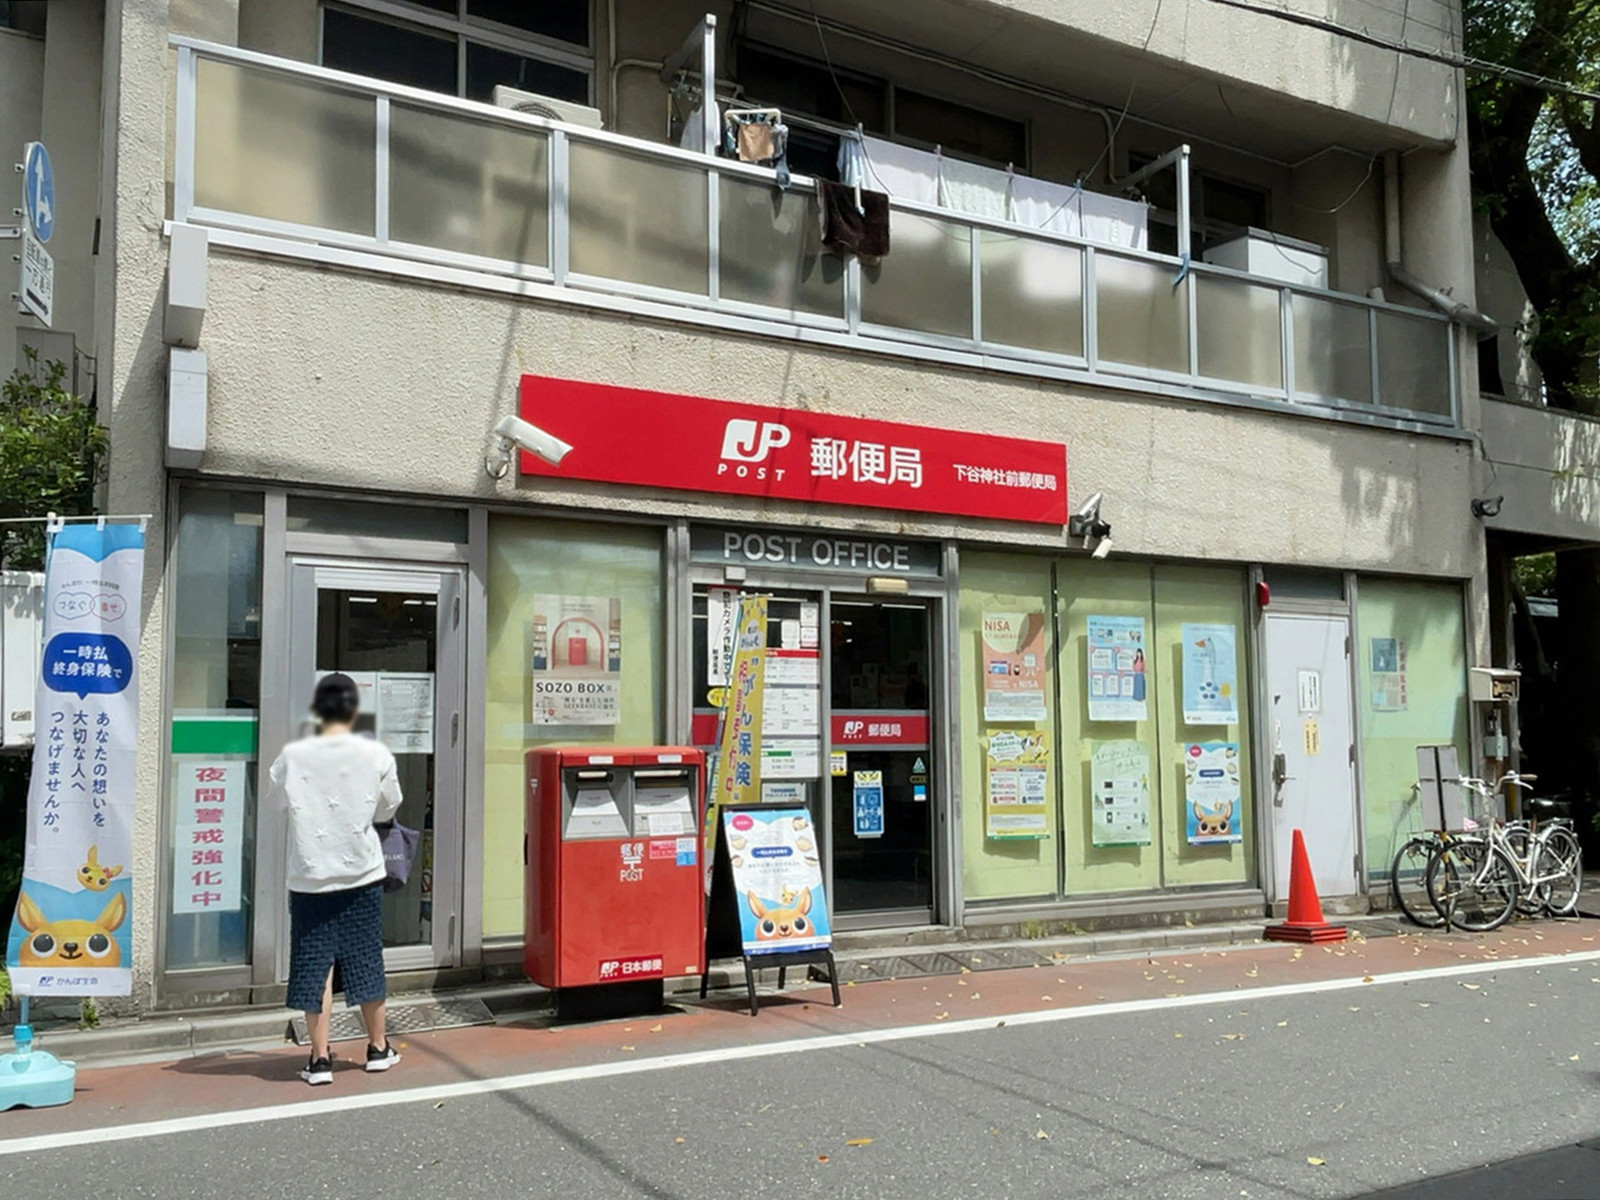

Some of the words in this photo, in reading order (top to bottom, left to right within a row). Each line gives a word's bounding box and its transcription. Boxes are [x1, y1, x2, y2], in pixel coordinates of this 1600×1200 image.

[717, 462, 786, 482] POST
[809, 436, 924, 489] 郵便局
[952, 463, 1057, 492] 下谷神社前郵便局
[723, 532, 802, 564] POST
[811, 538, 910, 571] OFFICE
[984, 620, 1011, 632] NISA
[63, 644, 108, 661] 一時払
[52, 661, 123, 679] 終身保険で
[536, 681, 573, 694] SOZO
[577, 682, 606, 694] BOX
[867, 723, 902, 737] 郵便局
[71, 710, 89, 793] 大切な人へ
[43, 711, 65, 834] つなげませんか。
[92, 711, 111, 828] あなたの想いを
[190, 766, 227, 907] 夜間警戒強化中
[620, 868, 643, 882] POST
[622, 958, 663, 974] 日本郵便
